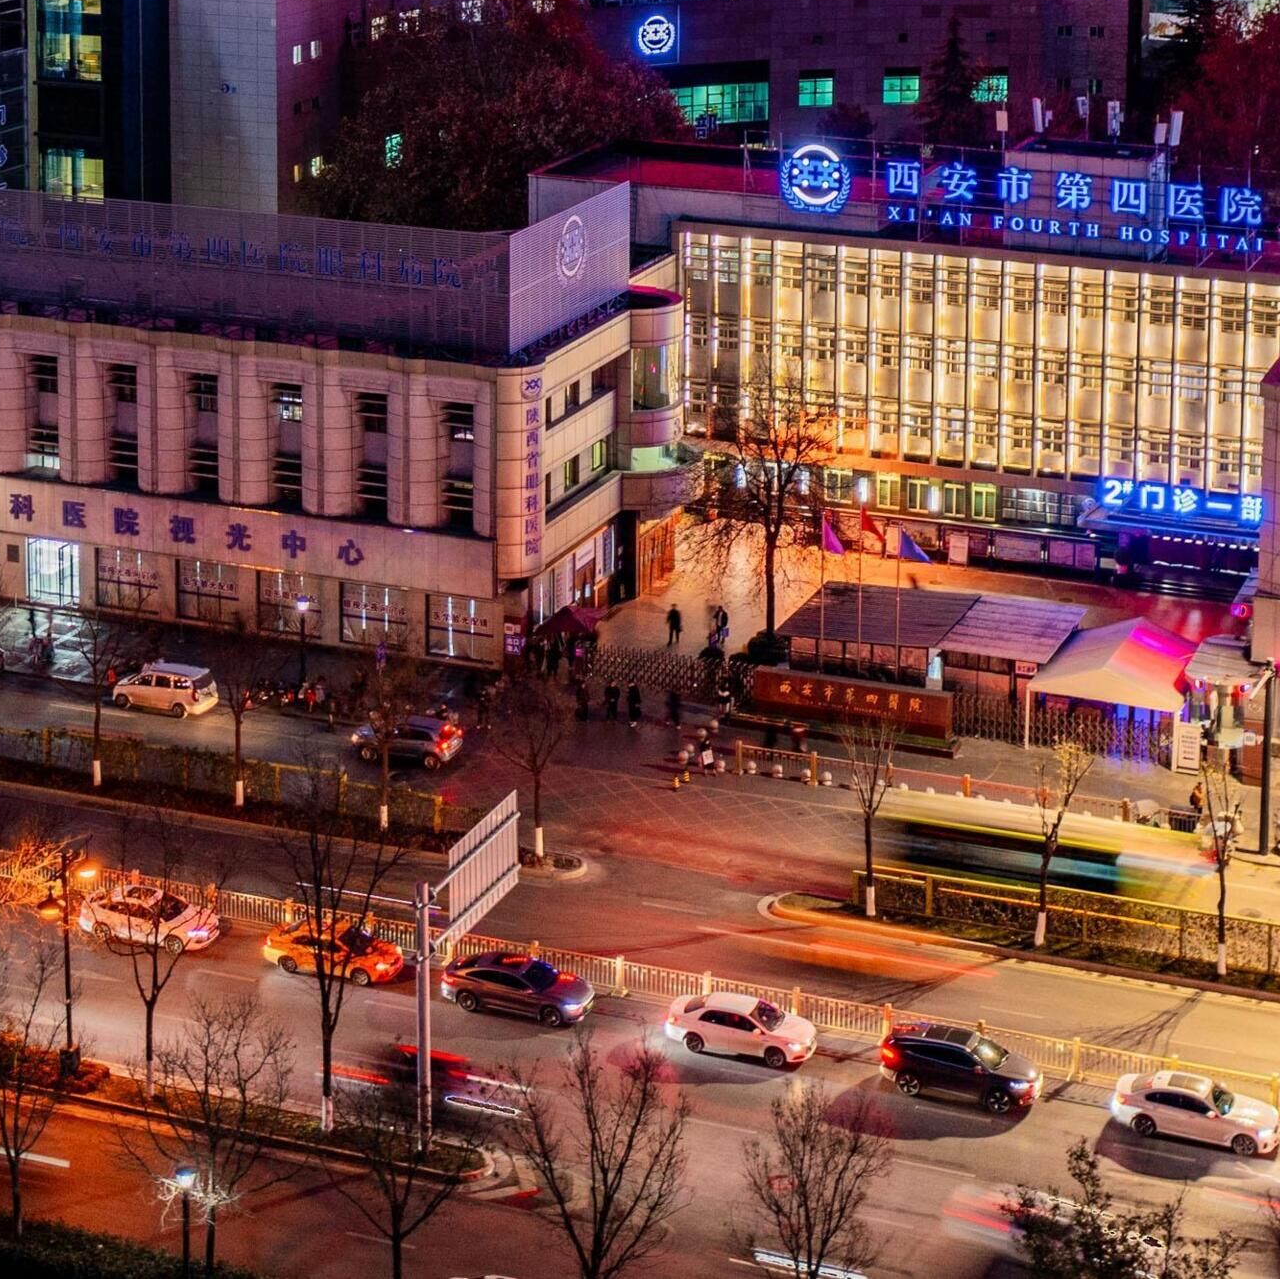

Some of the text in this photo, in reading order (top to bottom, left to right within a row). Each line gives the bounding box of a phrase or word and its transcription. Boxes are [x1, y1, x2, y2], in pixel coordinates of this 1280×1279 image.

[887, 159, 1263, 225] 西安市第四医院
[888, 205, 973, 226] XI'AN
[993, 215, 1100, 238] FOURTH
[524, 408, 541, 557] 陕西省眼科医院
